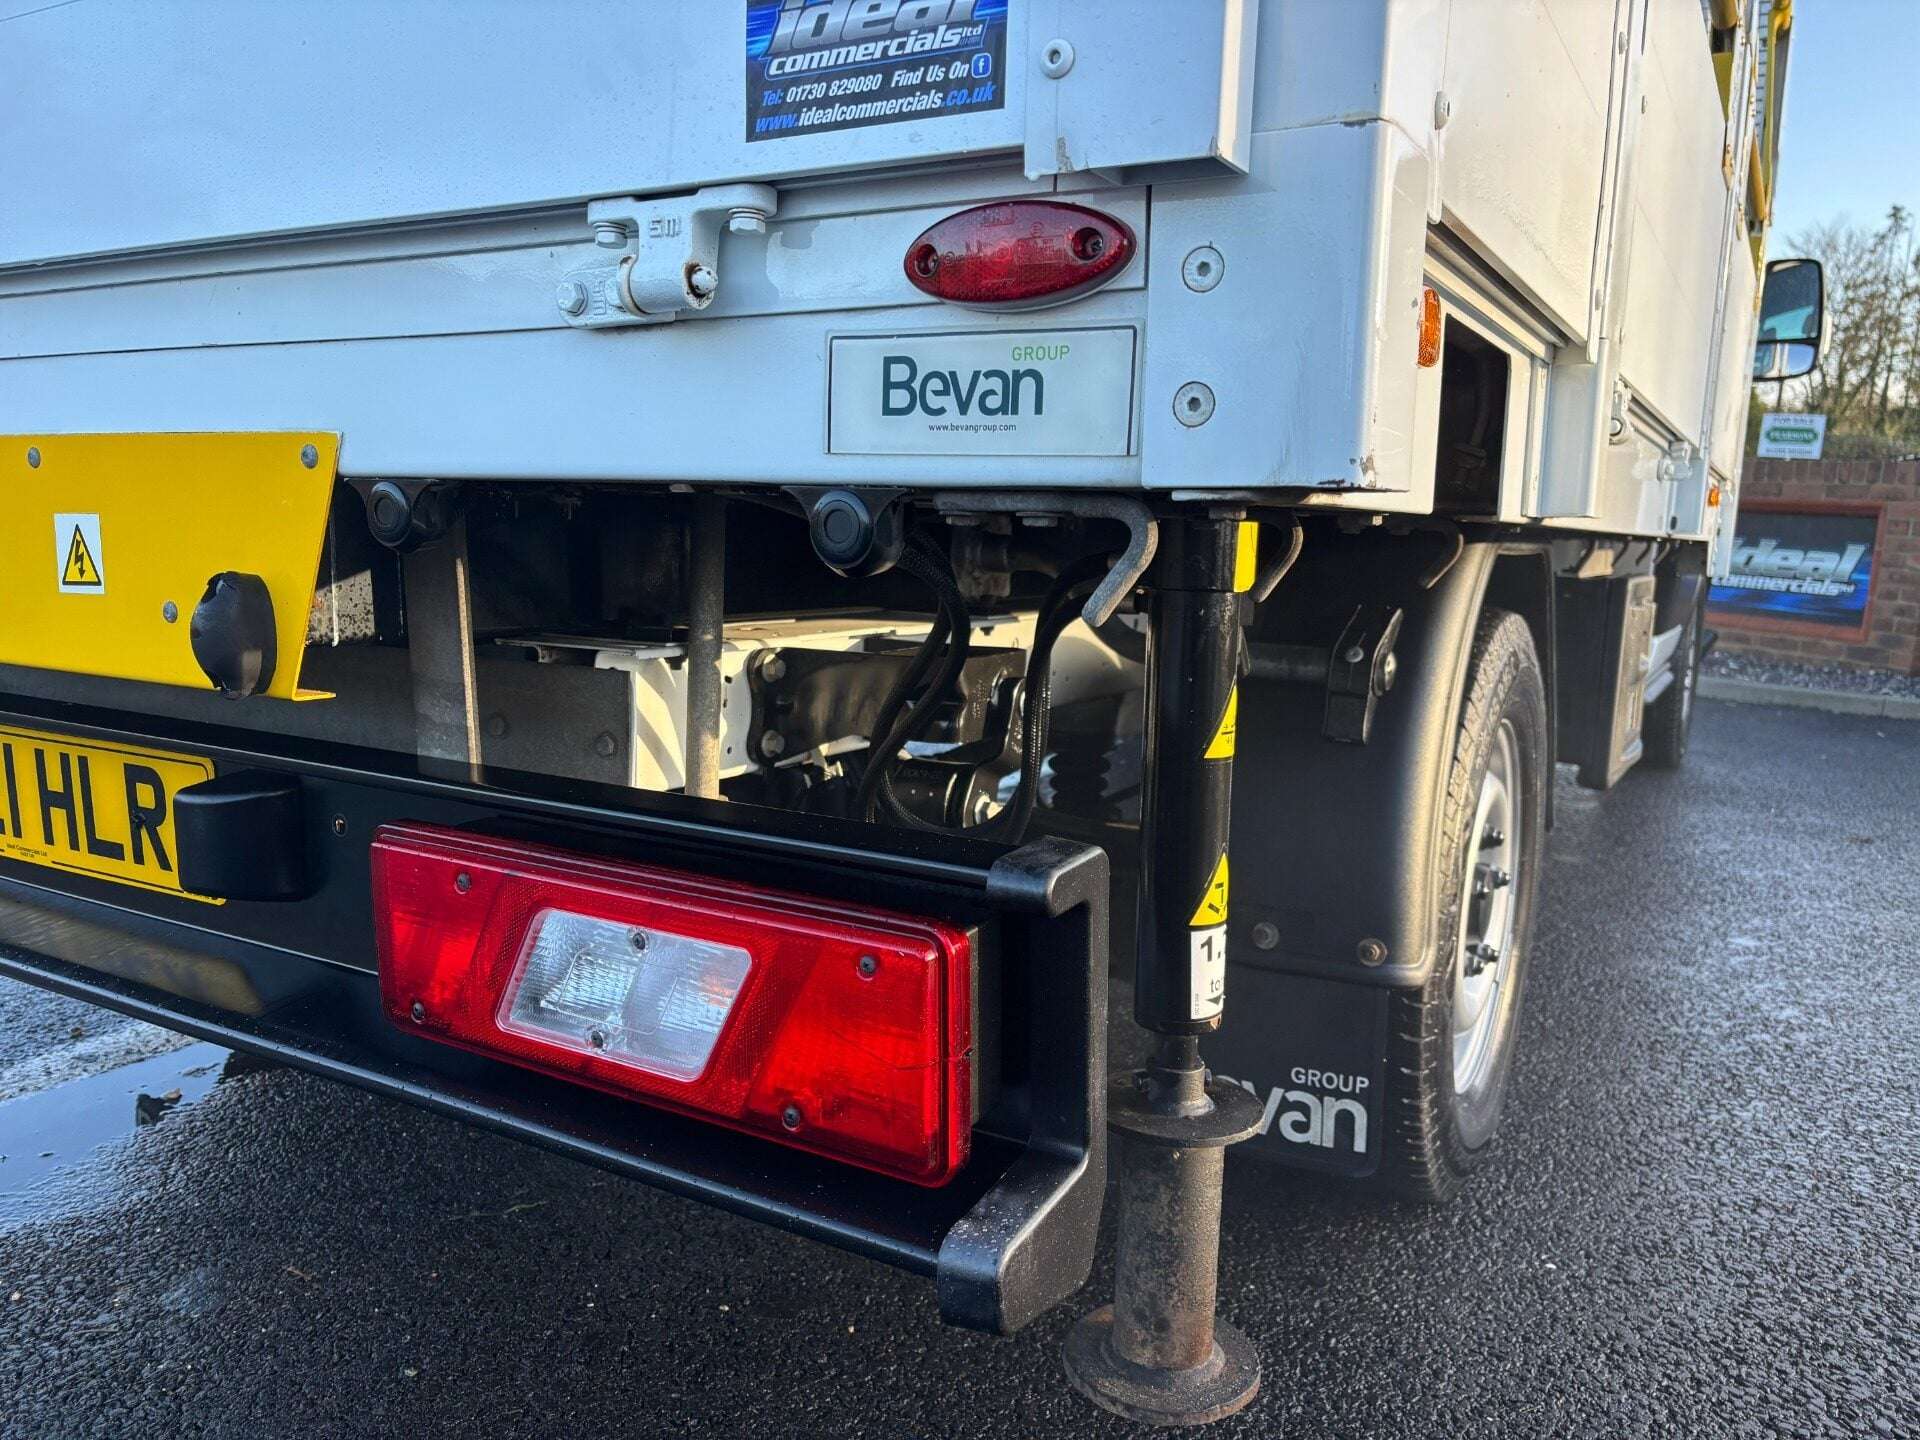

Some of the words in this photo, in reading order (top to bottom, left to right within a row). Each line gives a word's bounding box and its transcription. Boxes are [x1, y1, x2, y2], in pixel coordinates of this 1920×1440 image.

[768, 24, 962, 76] commercials
[761, 89, 784, 107] Tel:
[786, 82, 826, 103] 01730
[829, 74, 882, 98] 829080
[891, 67, 922, 88] Find
[926, 64, 945, 83] Us
[949, 61, 970, 79] On
[755, 82, 995, 133] www.idealcommercials.co.uk
[1011, 345, 1071, 362] GROUP
[881, 355, 1044, 417] Bevan
[928, 422, 1017, 433] www.bevangroup.com
[1291, 1067, 1369, 1094] GROUP
